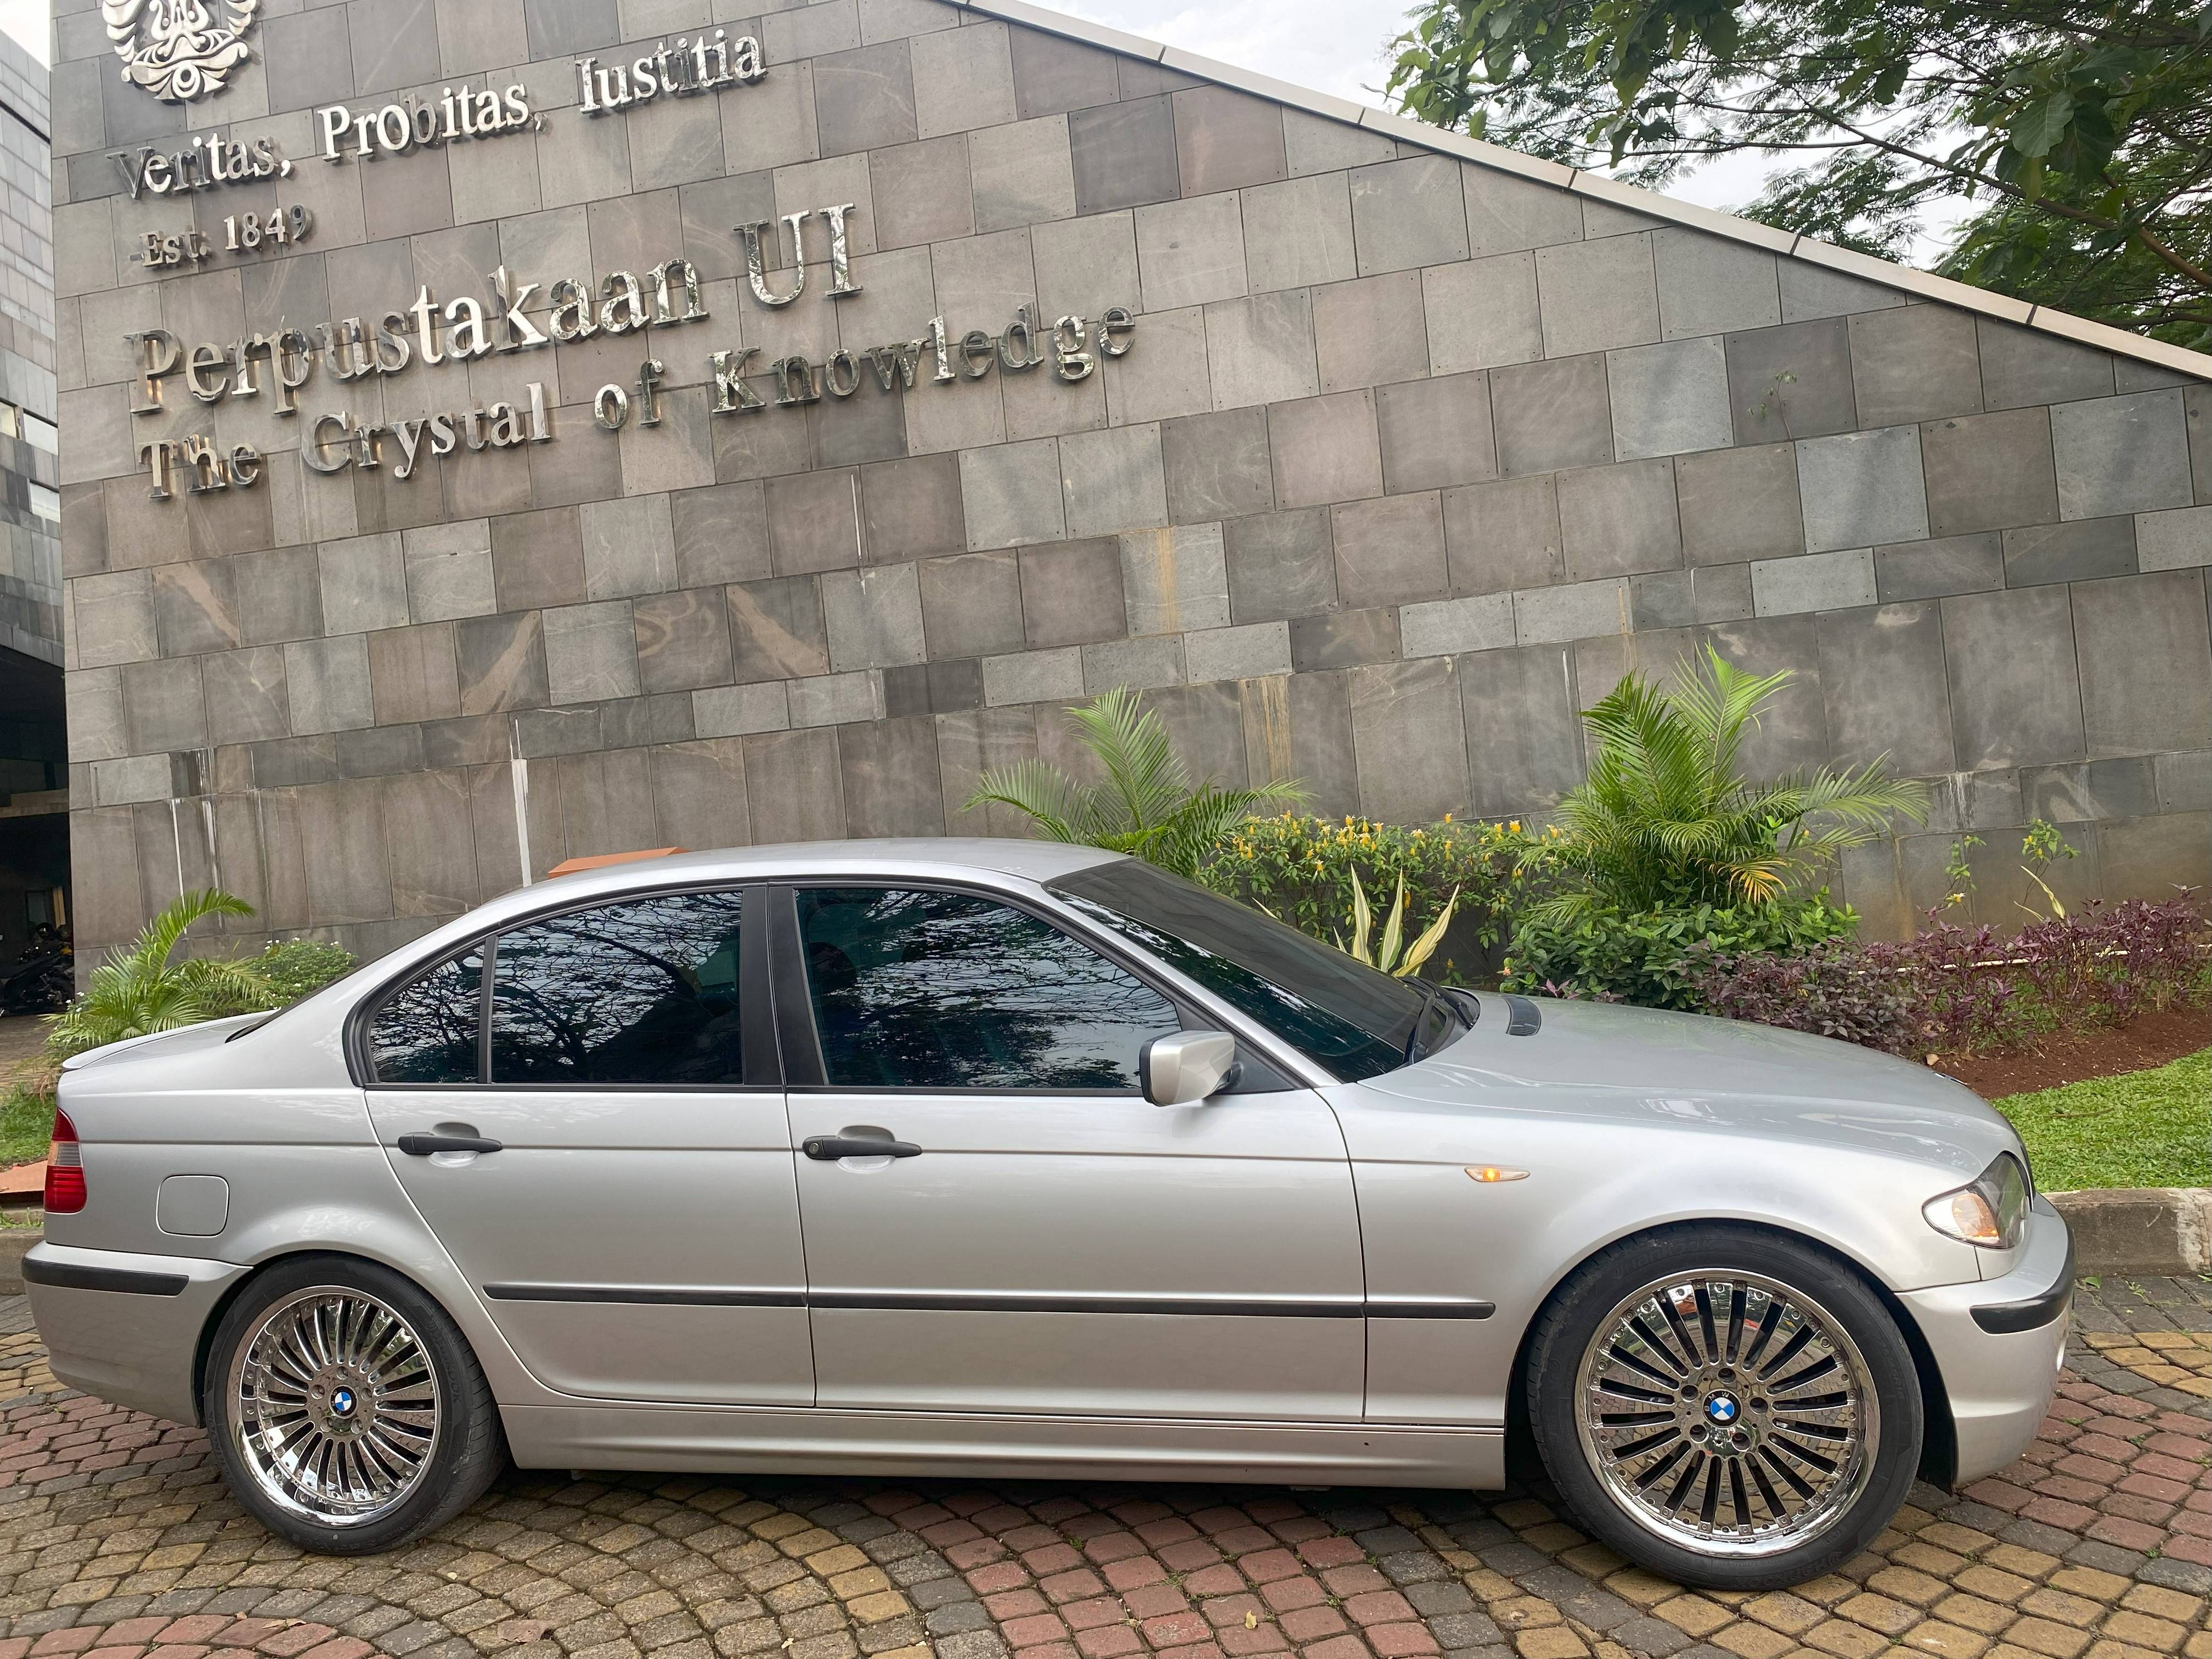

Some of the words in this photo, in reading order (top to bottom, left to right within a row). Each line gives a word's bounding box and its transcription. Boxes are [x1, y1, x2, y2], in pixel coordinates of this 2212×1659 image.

[105, 132, 291, 200] Veritas,
[317, 83, 548, 161] Probitas,
[574, 29, 767, 113] Iustitia
[123, 257, 710, 414] Perpustakaan
[732, 202, 864, 305] UI
[139, 230, 210, 267] Est.
[224, 204, 312, 251] 1849
[138, 433, 263, 499] The
[301, 382, 552, 480] Crystal
[594, 358, 665, 430] of
[708, 302, 1137, 414] Knowledge
[1704, 1391, 1730, 1412] BMW
